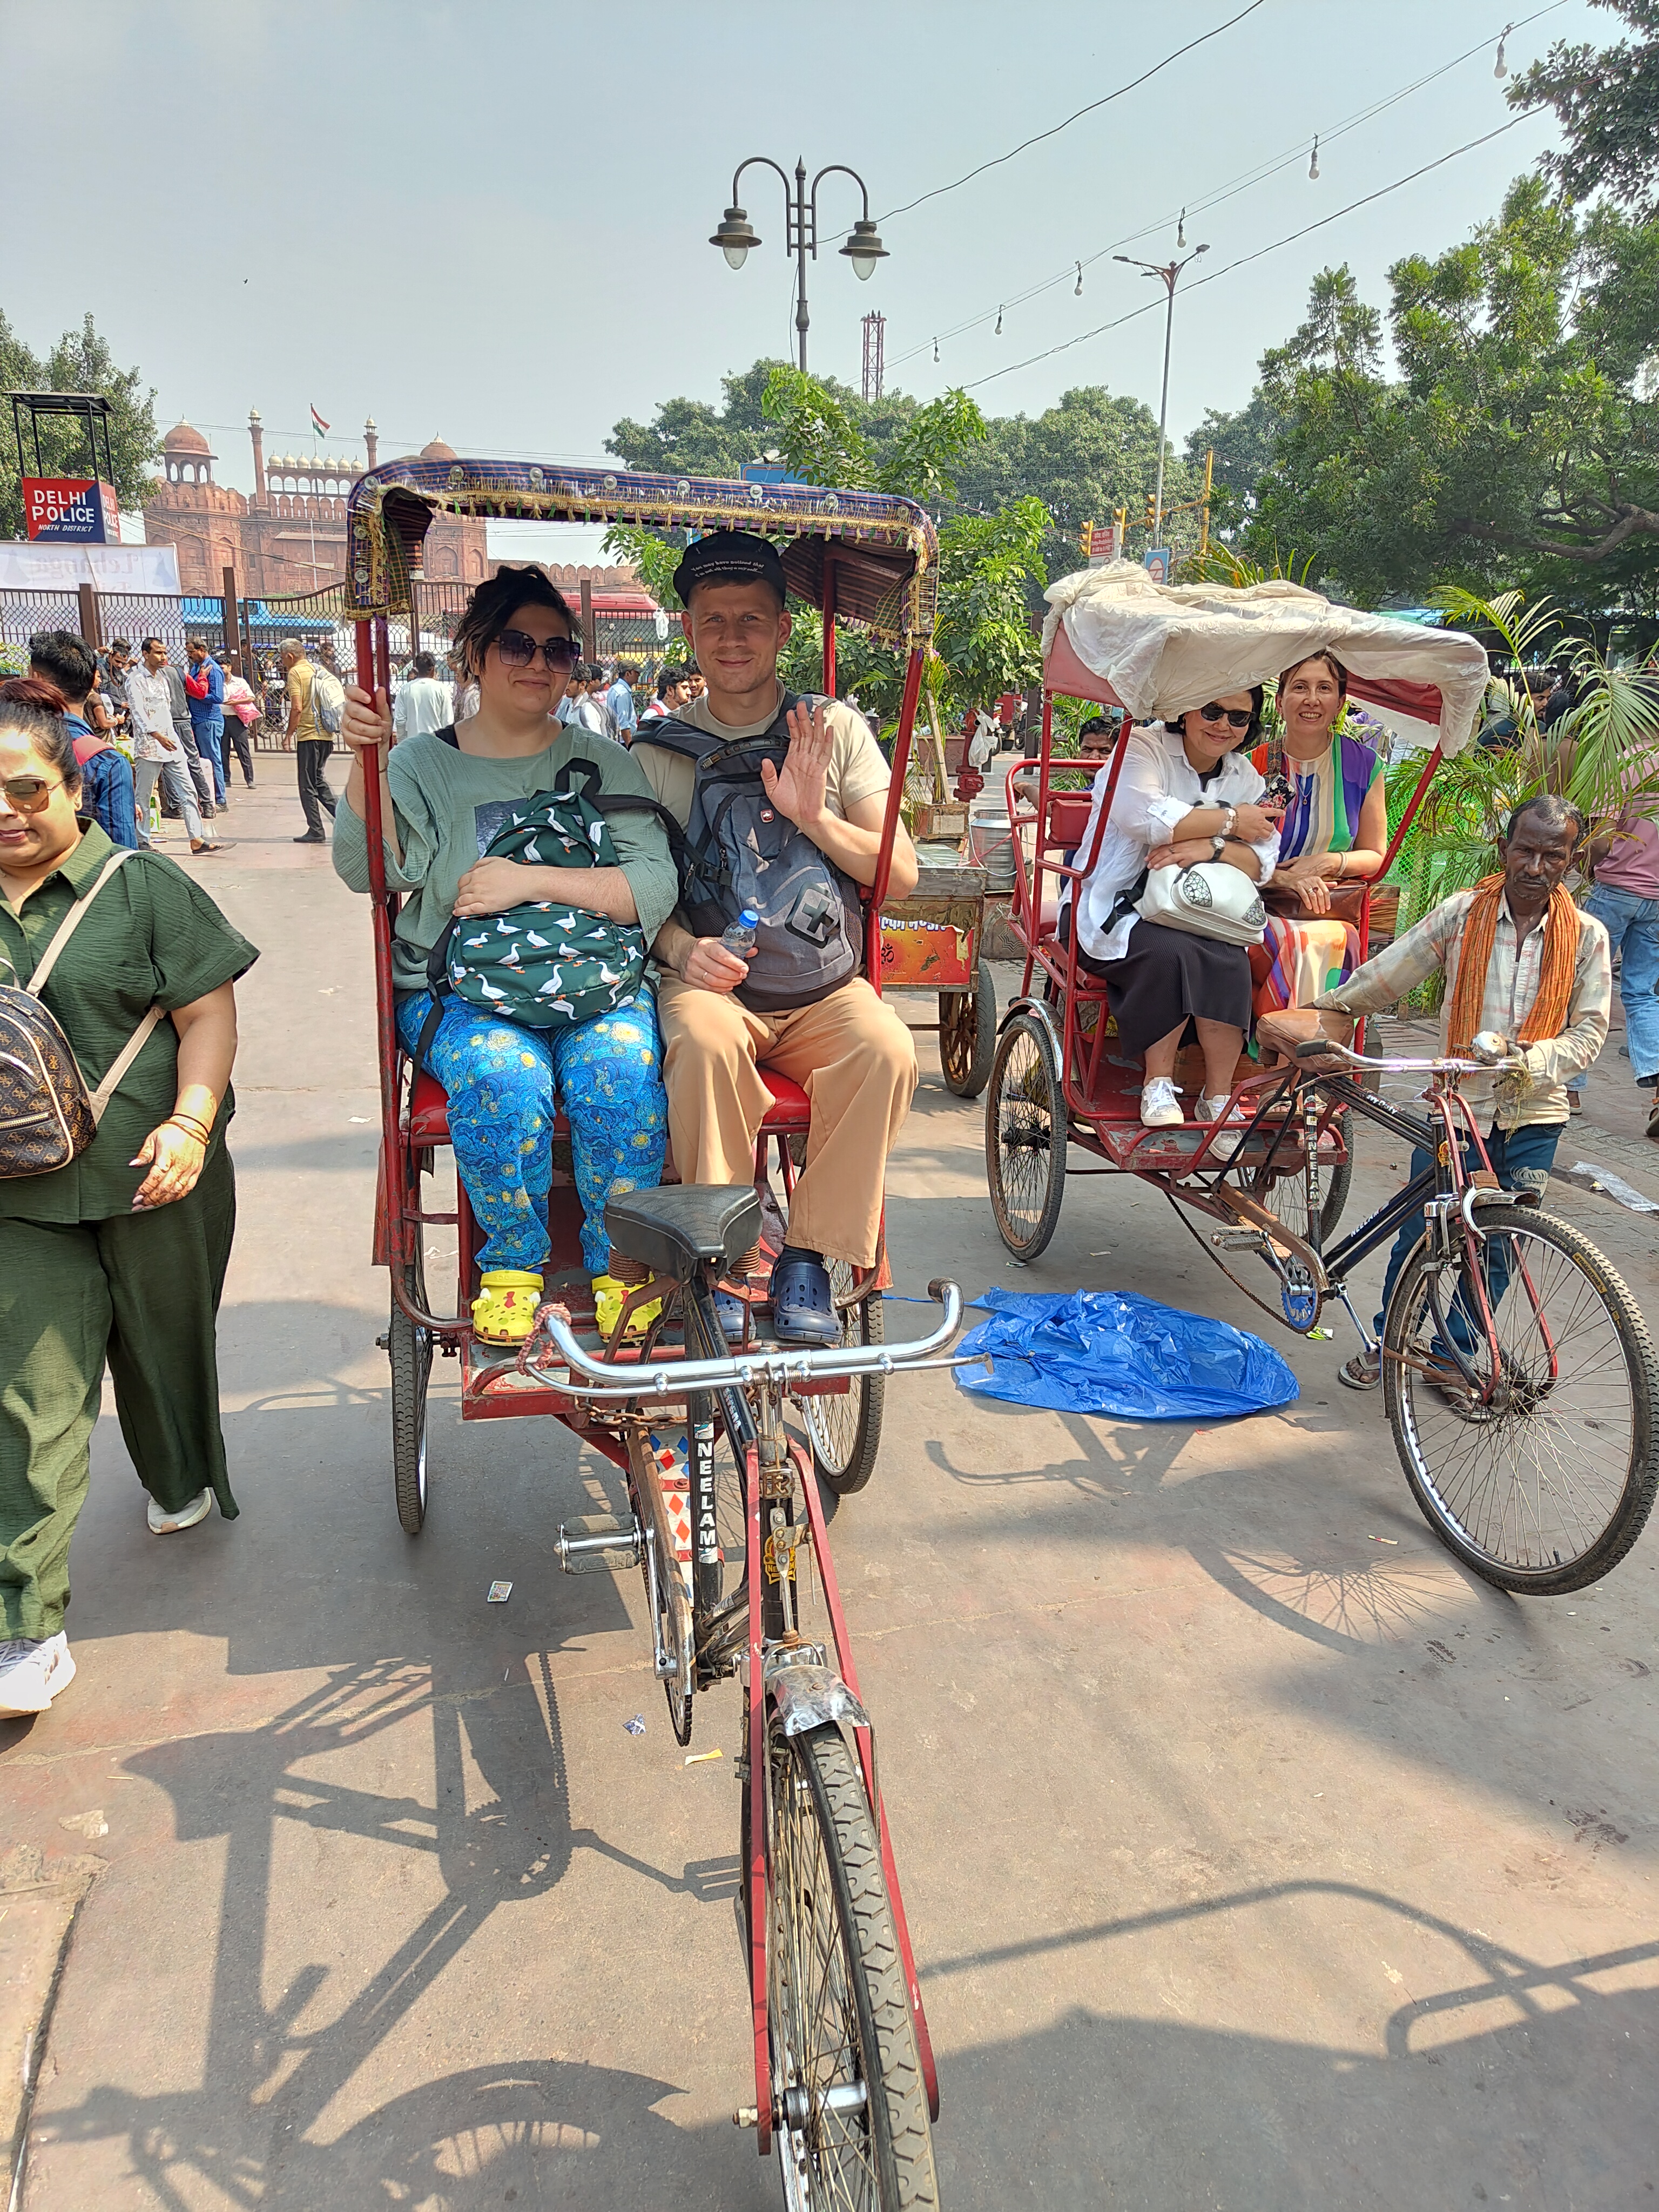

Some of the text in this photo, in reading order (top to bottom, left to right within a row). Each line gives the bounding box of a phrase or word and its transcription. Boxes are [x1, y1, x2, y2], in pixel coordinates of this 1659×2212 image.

[33, 490, 86, 505] DELHI
[102, 495, 116, 511] DELHI
[31, 506, 95, 523] POLICE
[103, 511, 118, 529] POLICE
[1308, 1141, 1320, 1200] NEELAM
[1351, 1211, 1379, 1238] NEELAM
[1547, 1232, 1568, 1250] HARTEX
[697, 1441, 716, 1546] NEELAM
